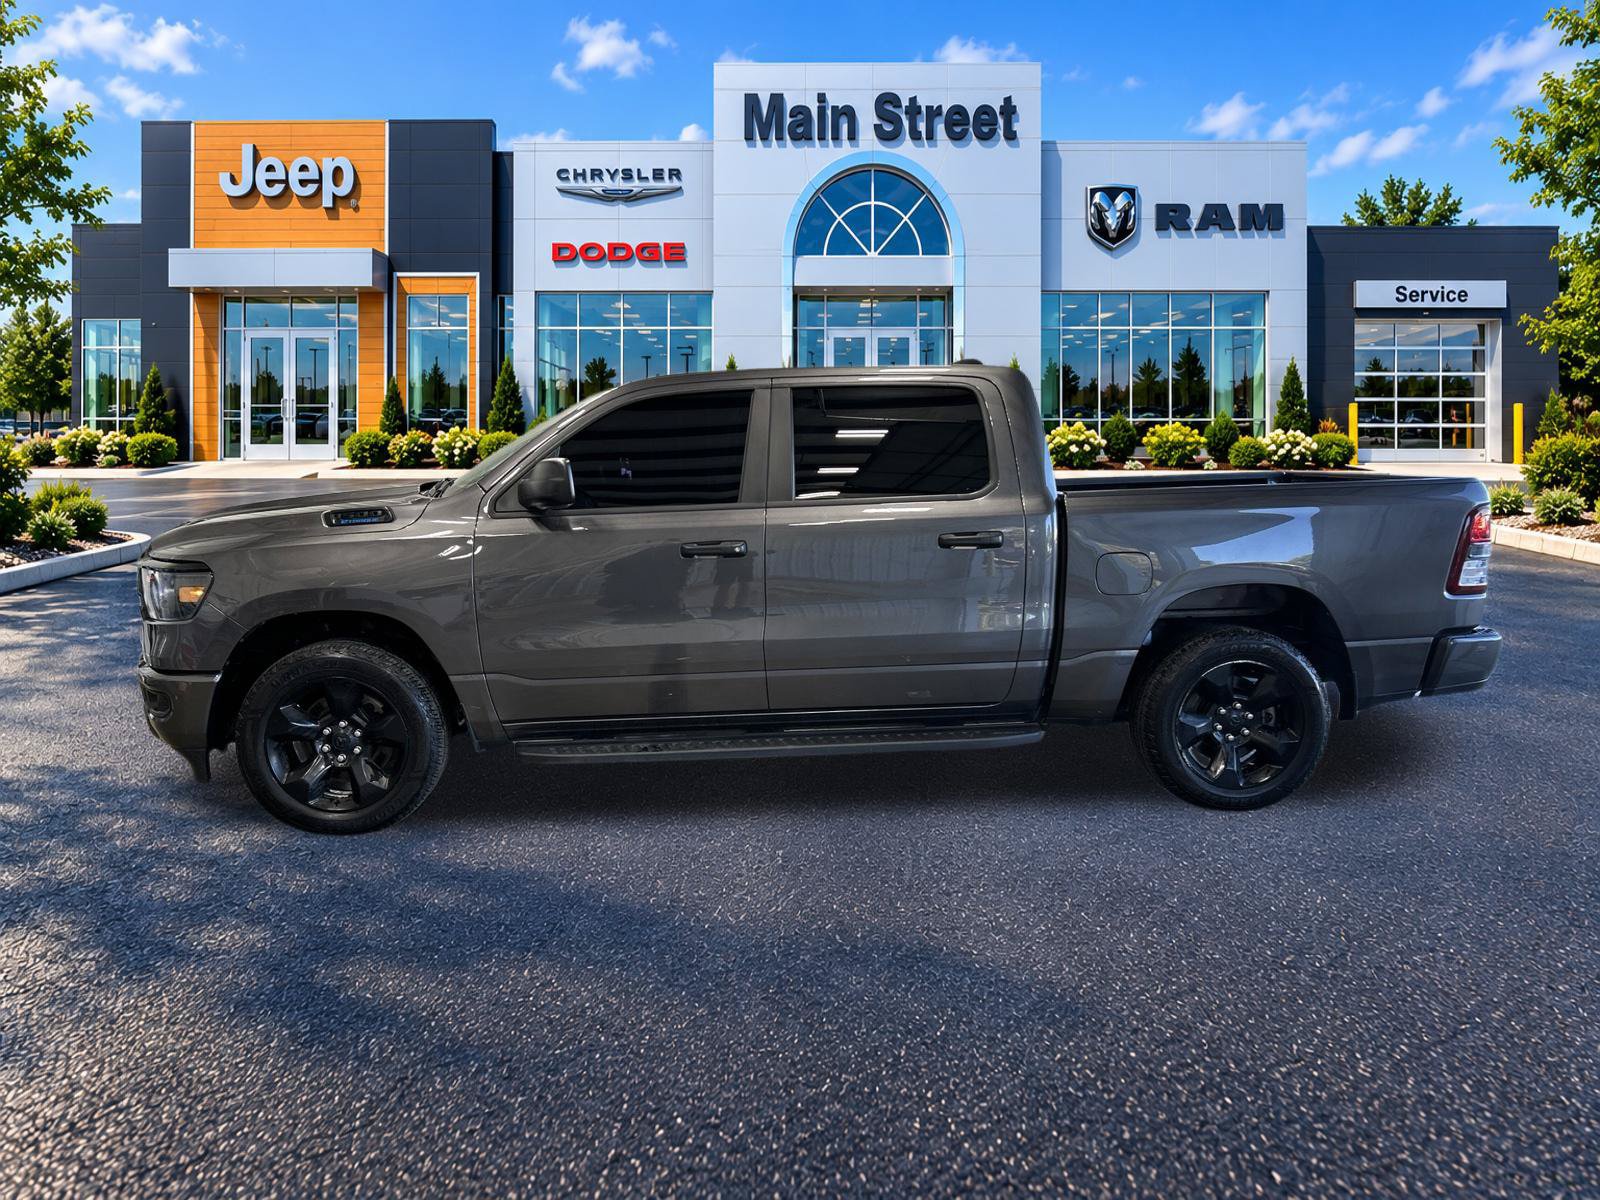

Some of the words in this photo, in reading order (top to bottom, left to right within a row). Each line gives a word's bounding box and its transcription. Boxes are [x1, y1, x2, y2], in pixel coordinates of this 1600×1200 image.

[744, 93, 858, 142] Main
[873, 91, 1019, 142] Street
[218, 143, 355, 209] Jeep
[555, 168, 683, 182] CHRYSLER
[1155, 203, 1285, 231] RAM
[551, 242, 687, 262] DODGE
[1395, 285, 1469, 303] Service
